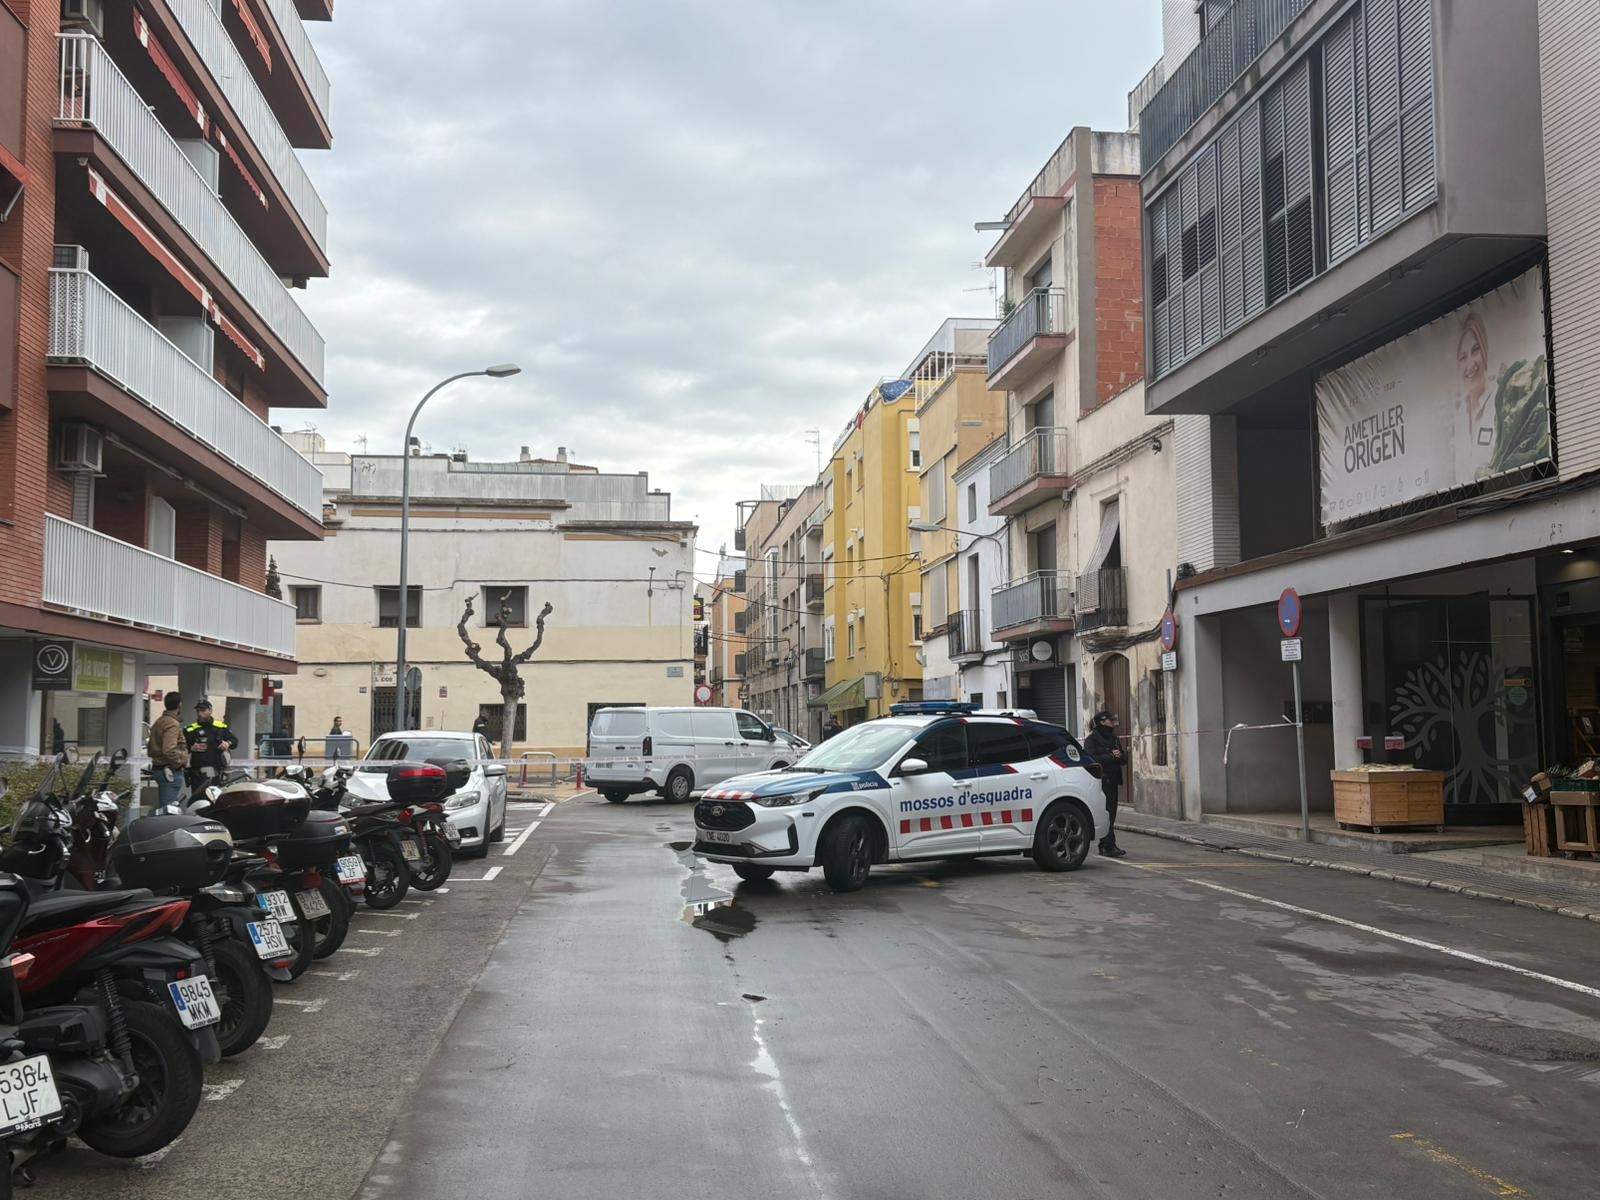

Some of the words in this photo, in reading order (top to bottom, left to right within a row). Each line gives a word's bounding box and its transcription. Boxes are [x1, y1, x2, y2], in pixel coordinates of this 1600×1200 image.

[1344, 404, 1404, 447] AMETLLER
[1344, 425, 1405, 474] ORIGEN
[900, 795, 954, 812] mossos
[957, 786, 1033, 806] d'esquadra
[256, 921, 281, 938] 2572
[181, 981, 211, 1003] 9845
[2, 1088, 39, 1121] LJF
